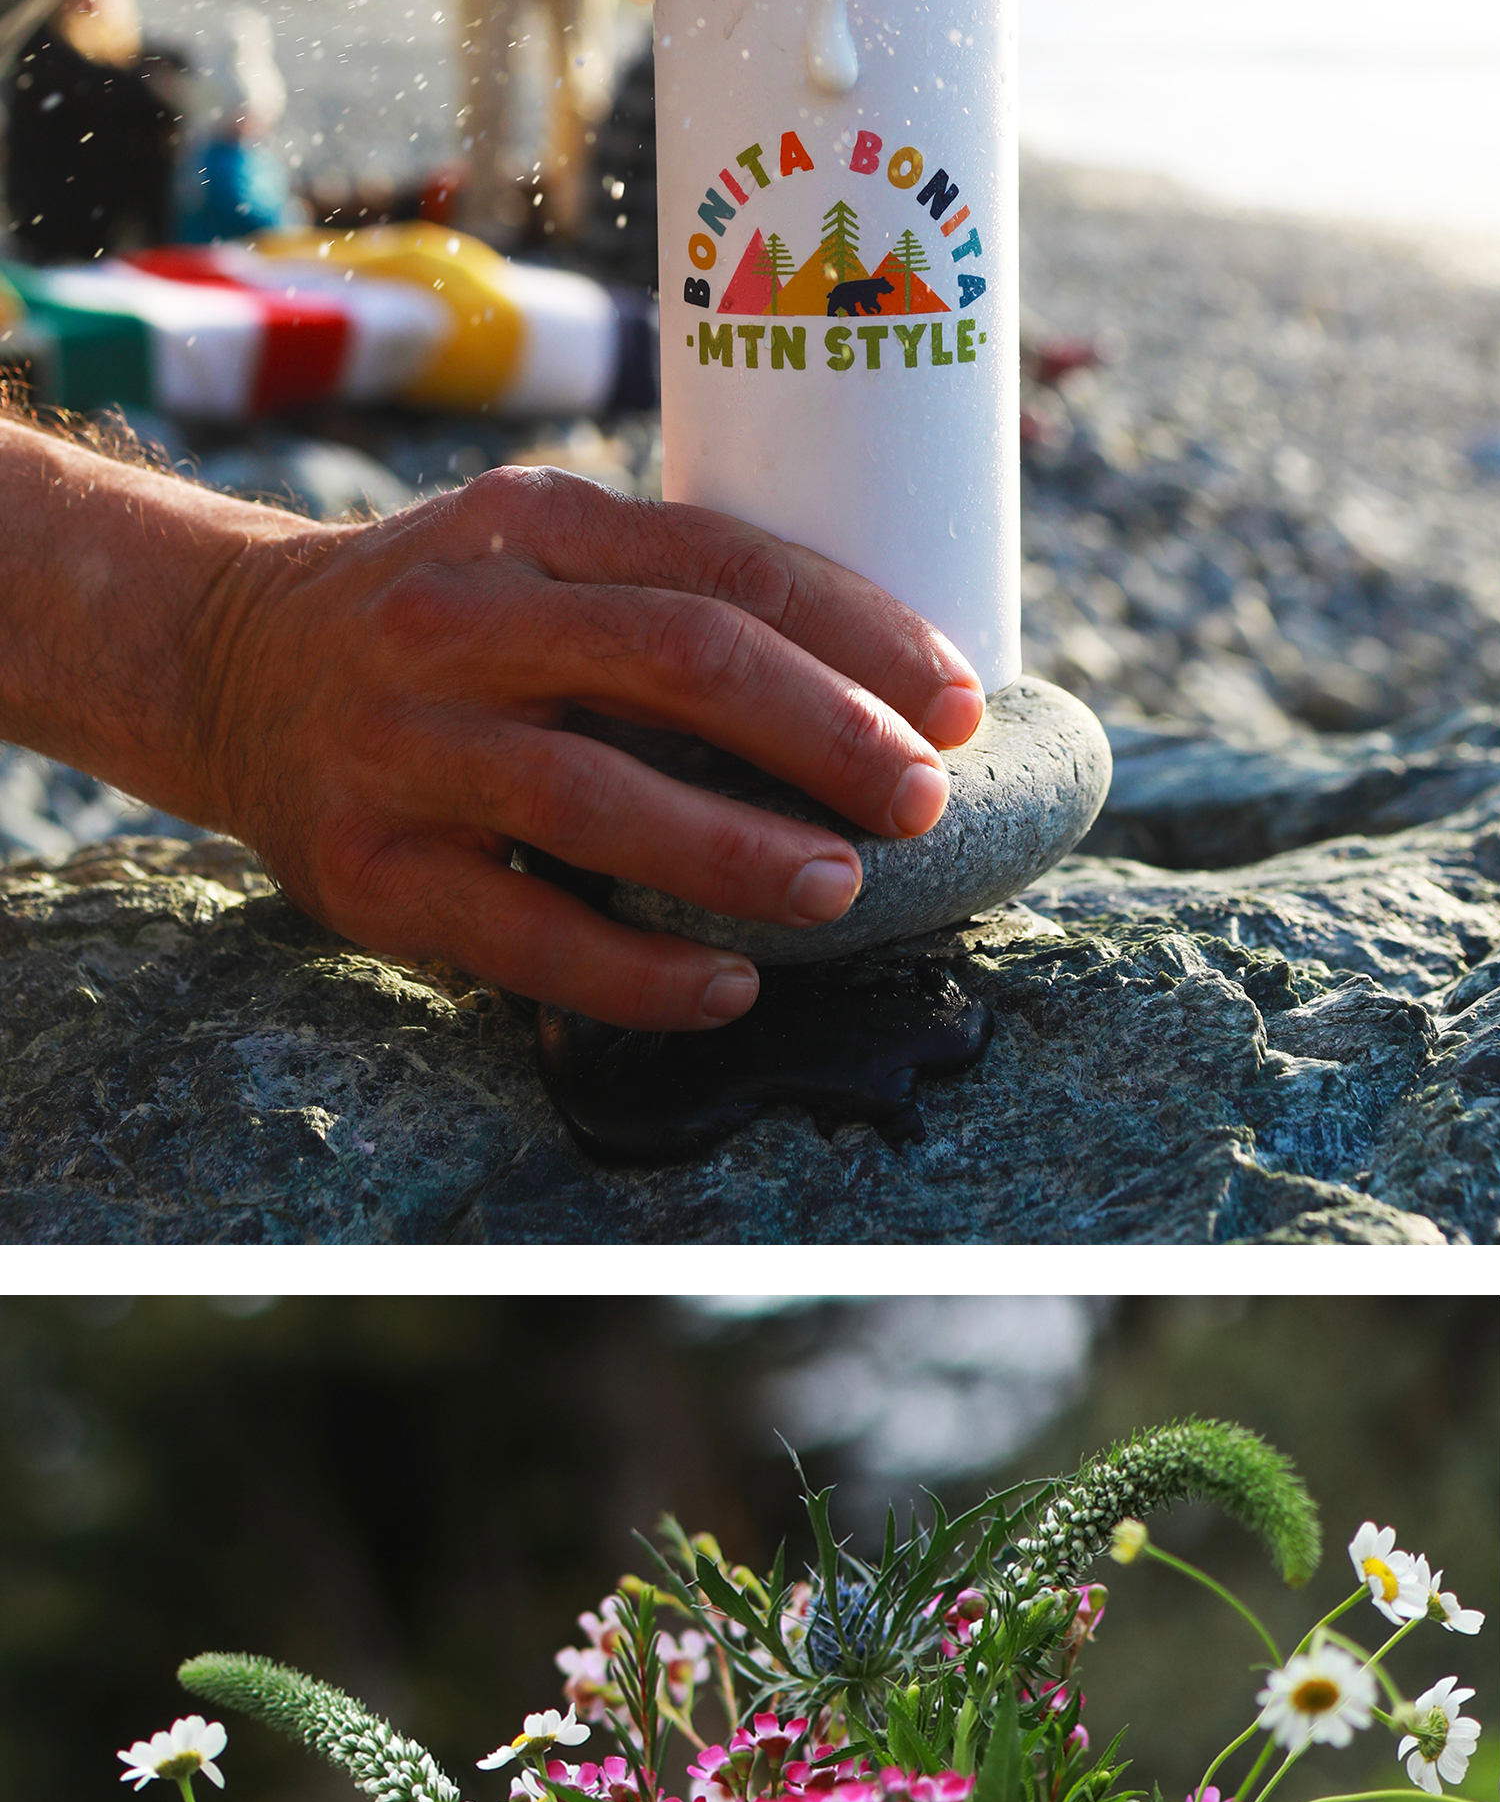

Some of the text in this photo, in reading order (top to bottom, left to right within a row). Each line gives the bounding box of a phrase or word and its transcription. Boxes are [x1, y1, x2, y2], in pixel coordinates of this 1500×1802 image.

[683, 129, 987, 309] BONITA BONITA
[698, 318, 977, 372] MTN STYLE
